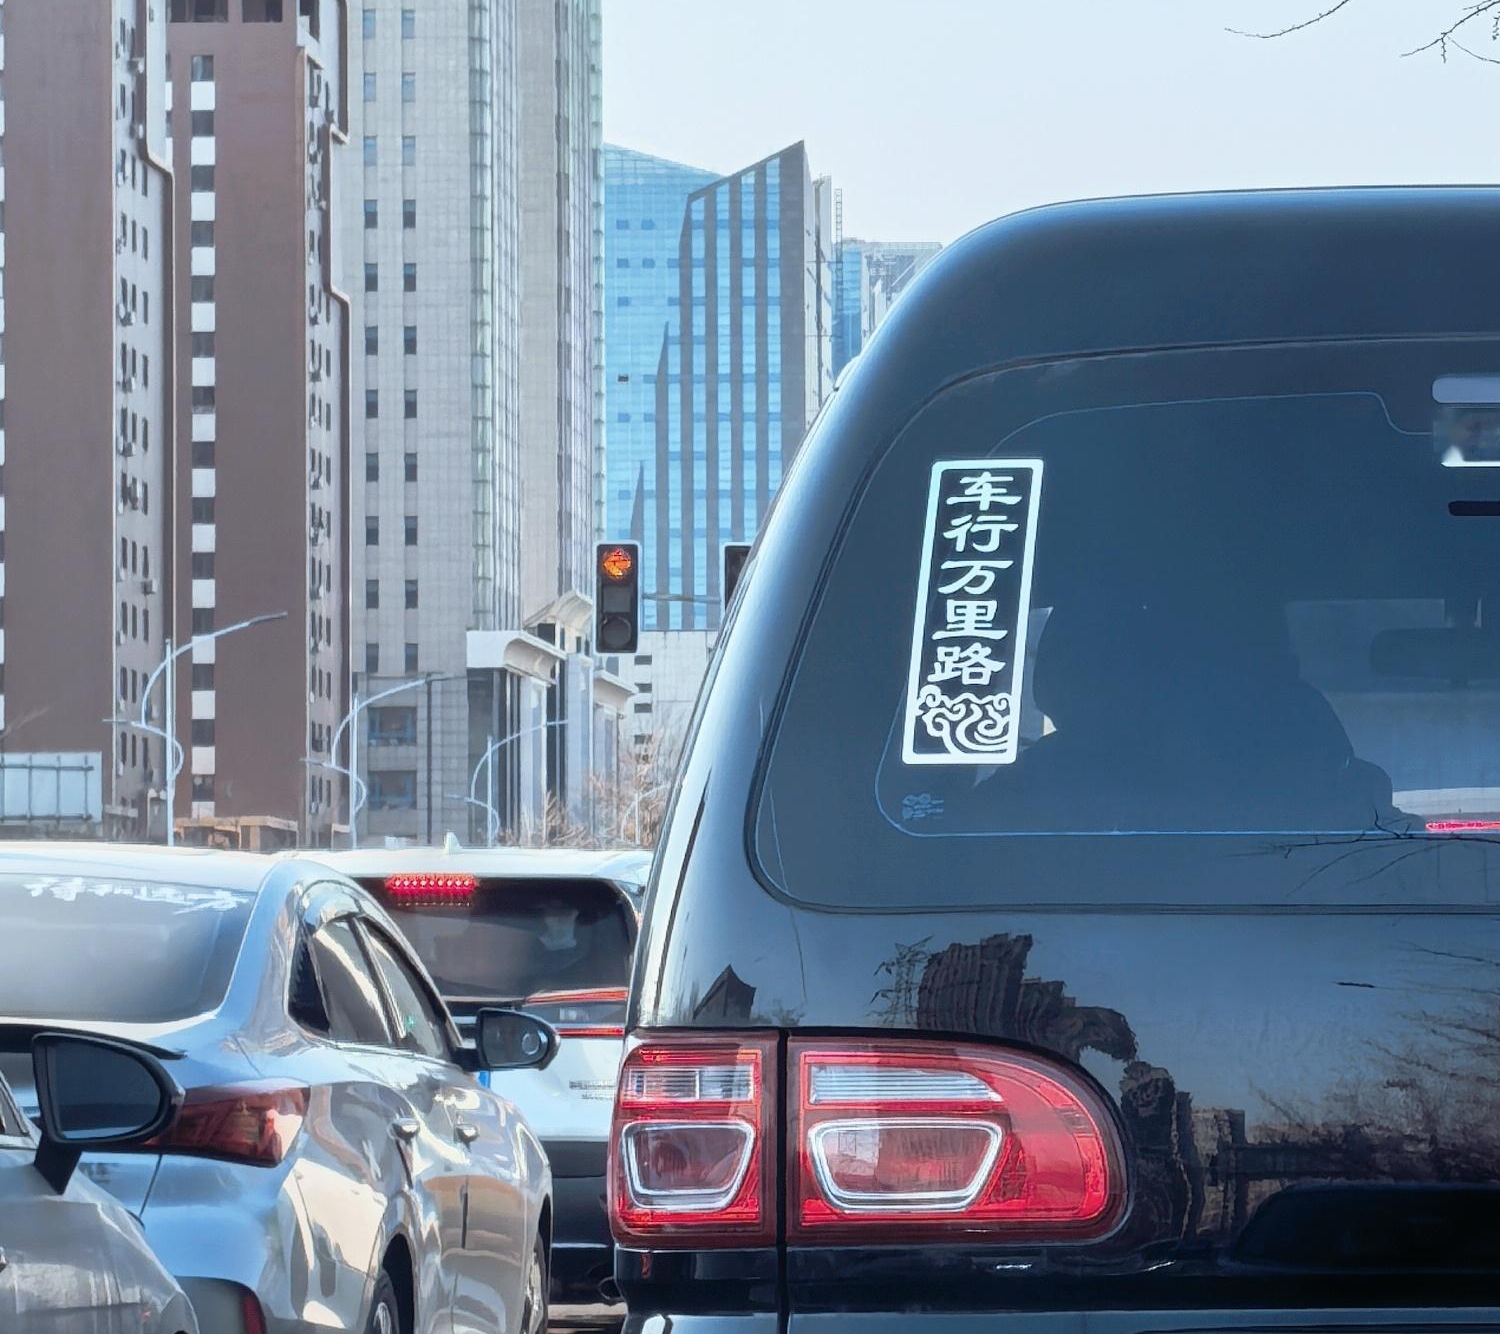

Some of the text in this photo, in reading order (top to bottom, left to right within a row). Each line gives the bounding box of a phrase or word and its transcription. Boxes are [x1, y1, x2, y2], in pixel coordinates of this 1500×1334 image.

[927, 471, 1022, 686] 车行万里路
